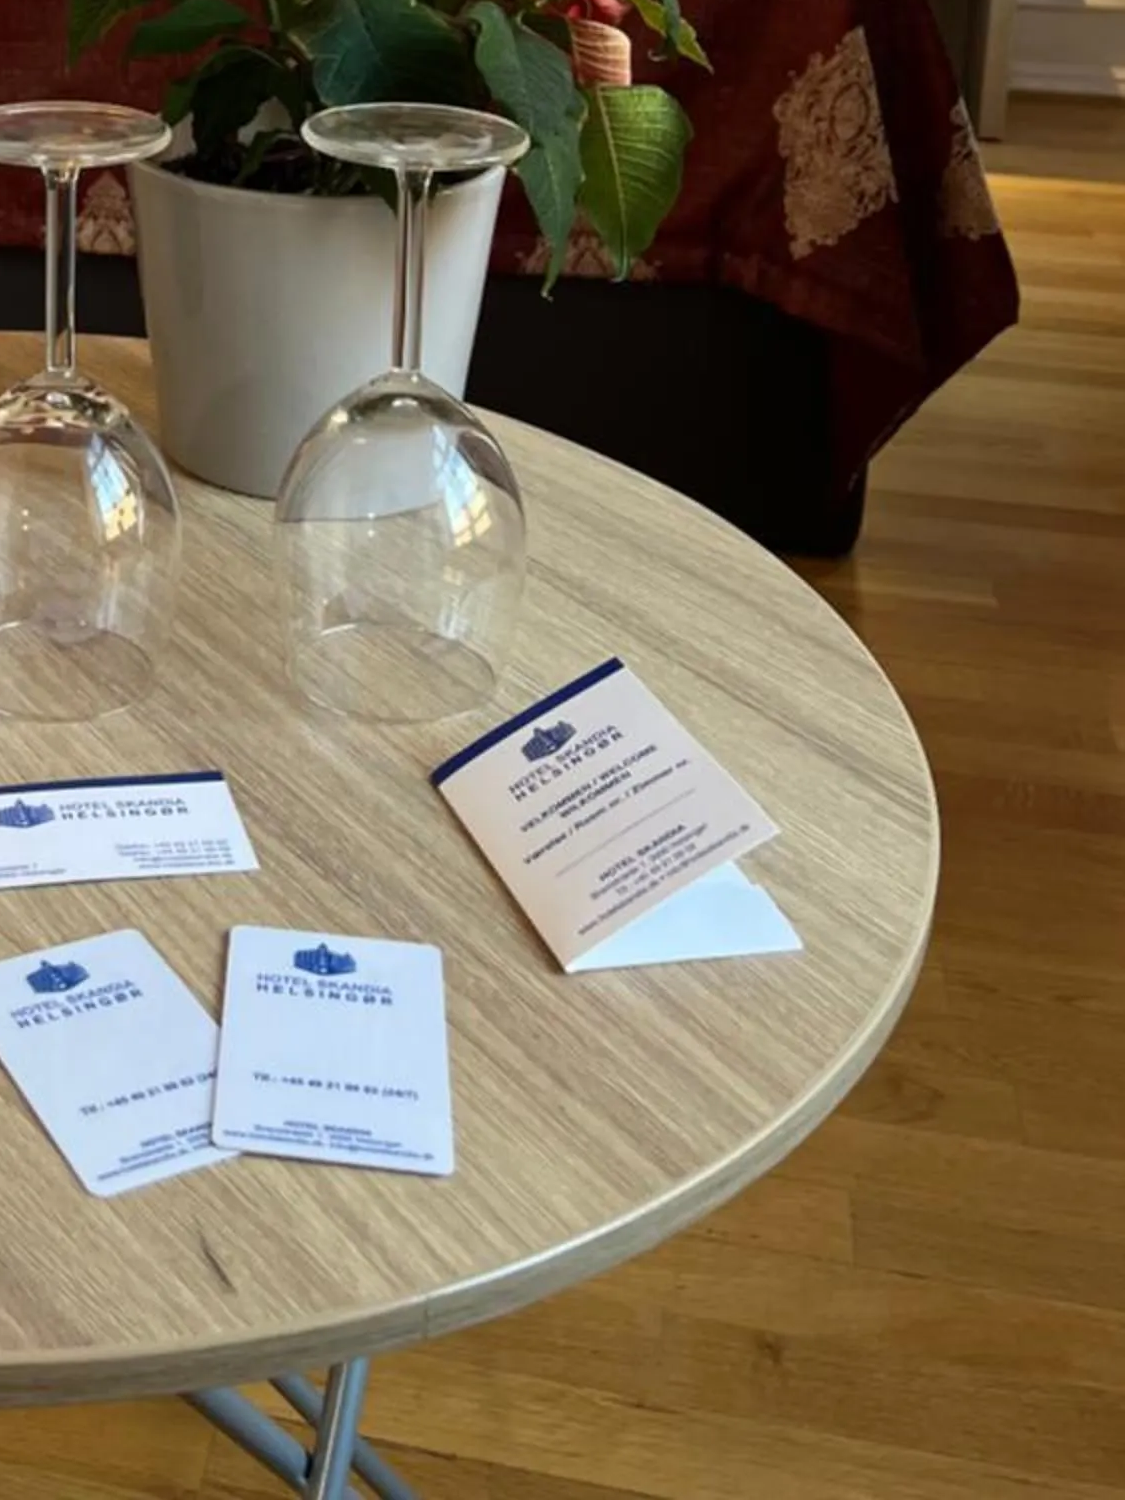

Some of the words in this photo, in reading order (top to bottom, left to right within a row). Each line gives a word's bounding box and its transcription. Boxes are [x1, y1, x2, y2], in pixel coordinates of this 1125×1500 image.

[509, 762, 553, 794] HOTEL
[555, 725, 618, 763] SKANDIA
[513, 731, 624, 801] HELSINGØR
[59, 801, 111, 812] HOTEL
[115, 797, 186, 808] SKANDIA
[520, 783, 592, 832] VELKOMMEN
[599, 744, 657, 781] WELCOME
[10, 1000, 60, 1019] HOTEL
[65, 979, 135, 1002] SKANDIA
[257, 973, 312, 988] HOTEL
[317, 977, 393, 995] SKANDIA
